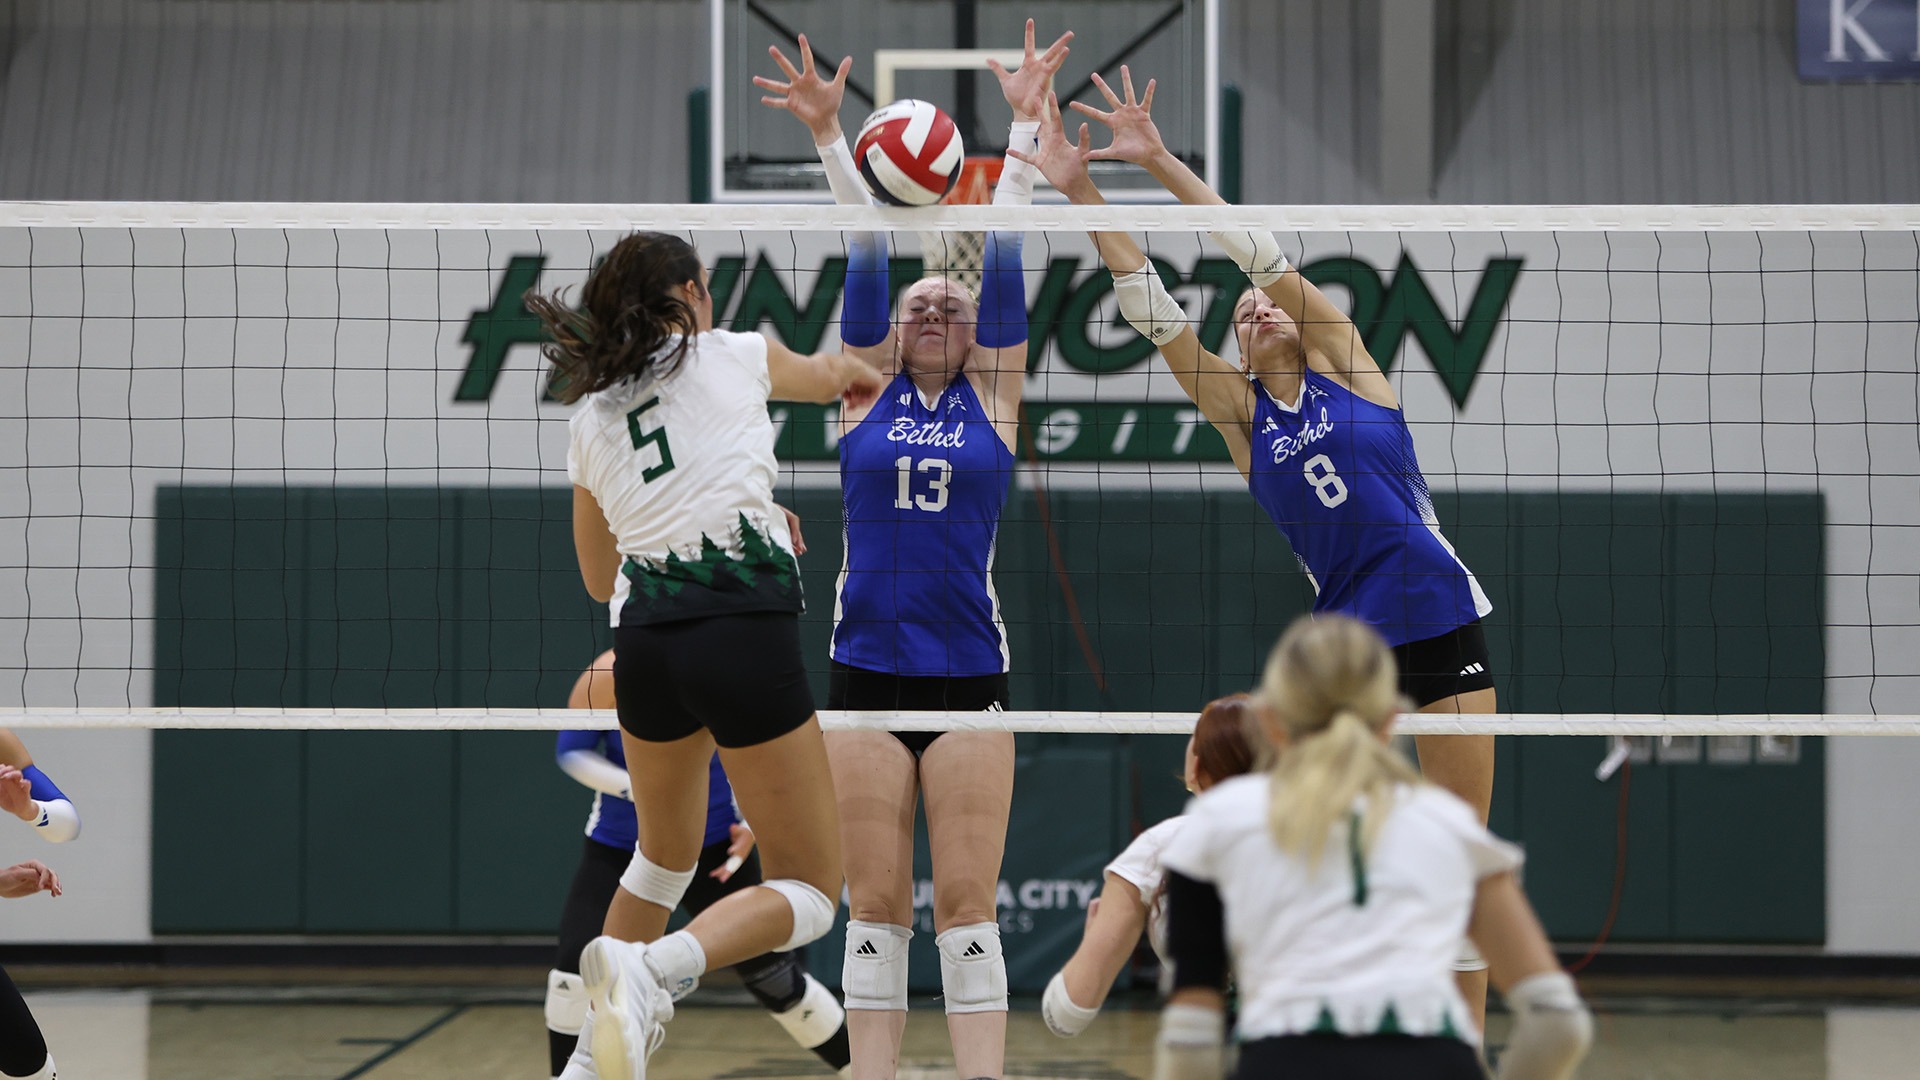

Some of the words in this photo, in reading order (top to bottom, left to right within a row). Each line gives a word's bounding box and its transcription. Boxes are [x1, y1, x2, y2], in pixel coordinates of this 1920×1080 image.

[1824, 0, 1920, 62] K
[626, 395, 676, 485] 5
[886, 416, 966, 448] Bethel
[894, 455, 953, 513] 13
[1303, 453, 1349, 509] 8
[1348, 814, 1369, 907] 1
[1018, 878, 1098, 911] CITY
